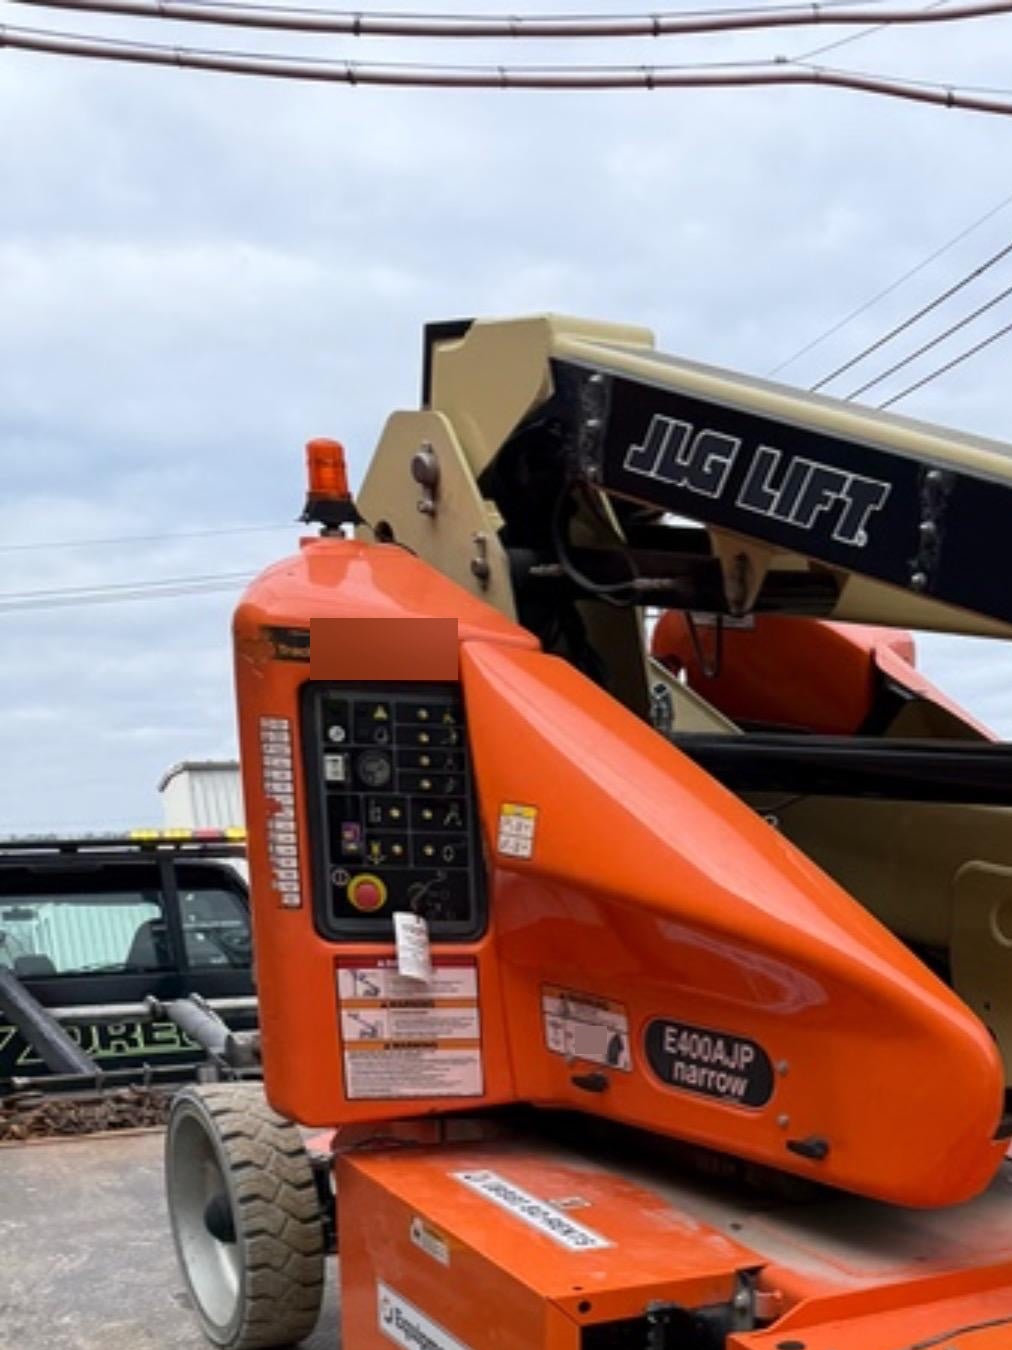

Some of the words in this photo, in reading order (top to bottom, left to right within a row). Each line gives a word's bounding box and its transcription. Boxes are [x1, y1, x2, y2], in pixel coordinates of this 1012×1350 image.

[623, 413, 742, 499] JLG
[663, 1025, 755, 1071] E400AJP
[672, 1060, 749, 1098] narrow
